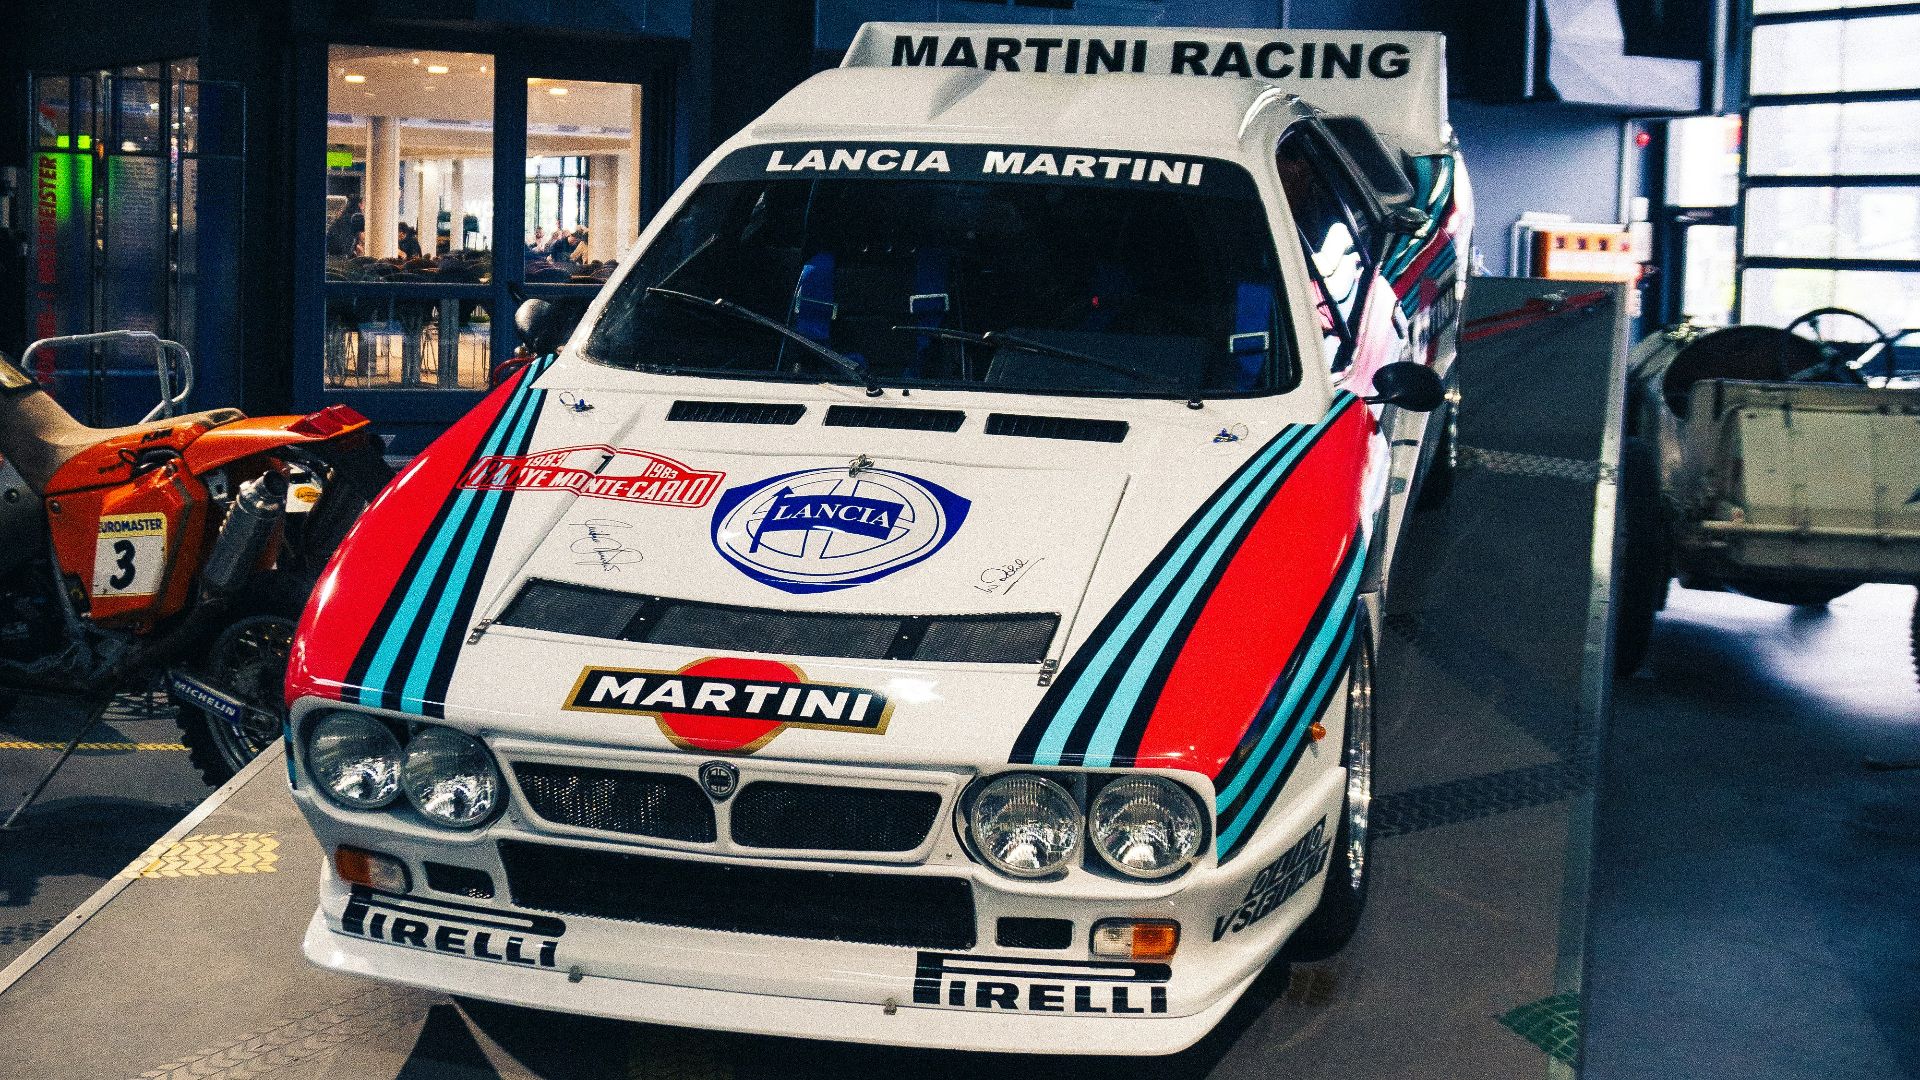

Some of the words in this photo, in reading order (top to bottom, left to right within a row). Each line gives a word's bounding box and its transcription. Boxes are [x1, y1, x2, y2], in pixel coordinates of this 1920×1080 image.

[890, 35, 1148, 75] MARTINI
[1170, 40, 1411, 79] RACING
[765, 149, 951, 172] LANCIA
[982, 150, 1204, 186] MARTINI
[524, 452, 567, 467] 1983
[644, 461, 679, 480] 1983
[547, 470, 711, 504] MONTE-CARLO
[772, 503, 891, 529] LANCIA
[109, 539, 136, 591] 3
[174, 681, 237, 717] MICHELIN
[589, 675, 873, 722] MARTINI
[341, 883, 567, 968] PIRELLI
[912, 950, 1173, 1014] PIRELLI
